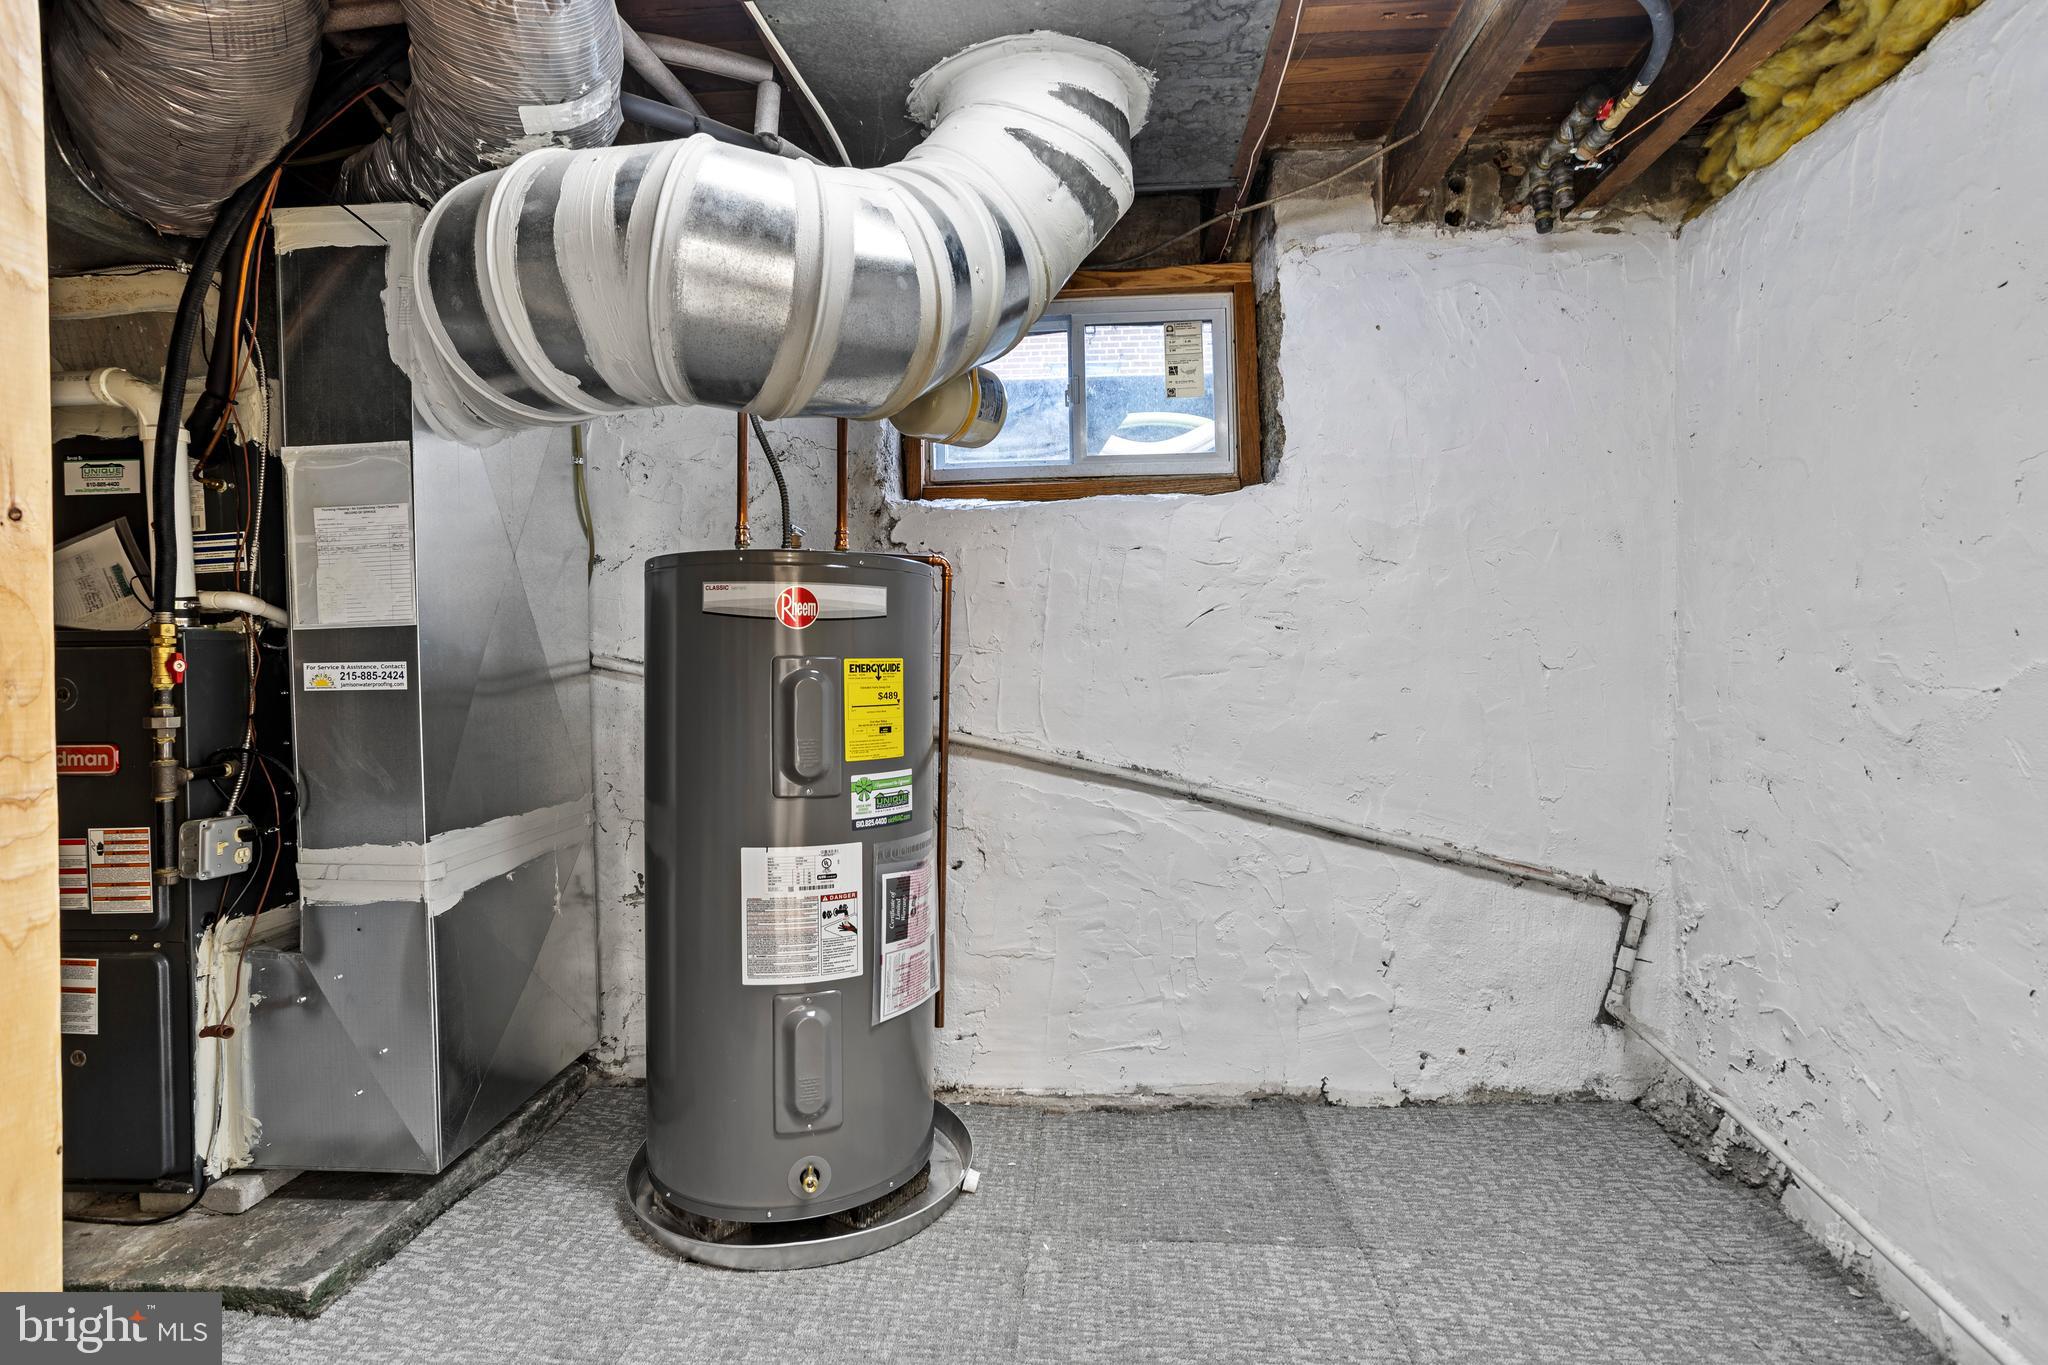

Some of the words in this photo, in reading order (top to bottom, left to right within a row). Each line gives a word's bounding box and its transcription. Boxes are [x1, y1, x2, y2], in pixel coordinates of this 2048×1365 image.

[83, 467, 121, 475] UNIQUE
[781, 587, 816, 623] Rheem
[849, 663, 901, 673] ENERGYGUIDE
[339, 671, 405, 681] 215-885-2424
[878, 691, 898, 700] $489
[876, 794, 909, 805] UNIQUE
[829, 892, 856, 900] DANGER
